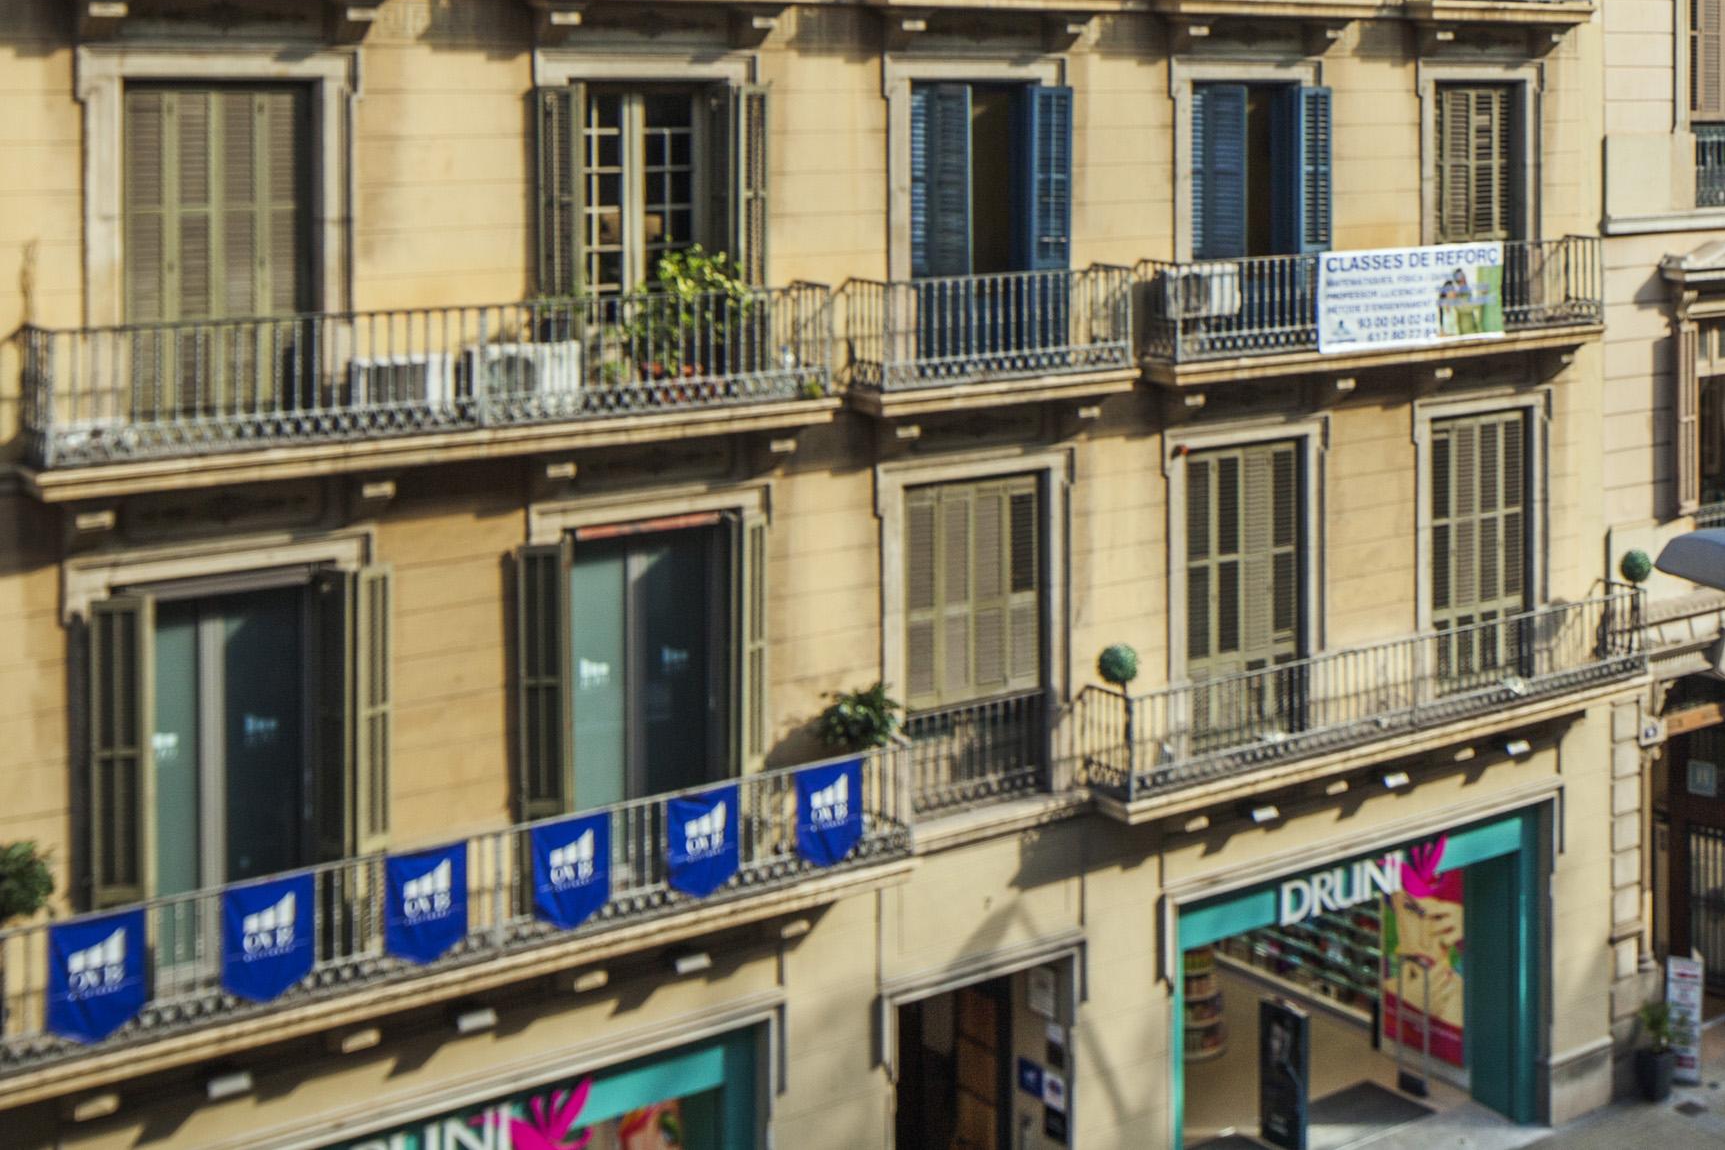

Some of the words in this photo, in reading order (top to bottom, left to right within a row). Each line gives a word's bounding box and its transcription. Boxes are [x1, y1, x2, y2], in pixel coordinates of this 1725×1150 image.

[1326, 253, 1403, 273] CLASSES
[1409, 252, 1429, 268] DE
[1435, 248, 1497, 267] REFORÇ
[1280, 850, 1403, 927] DRUNI
